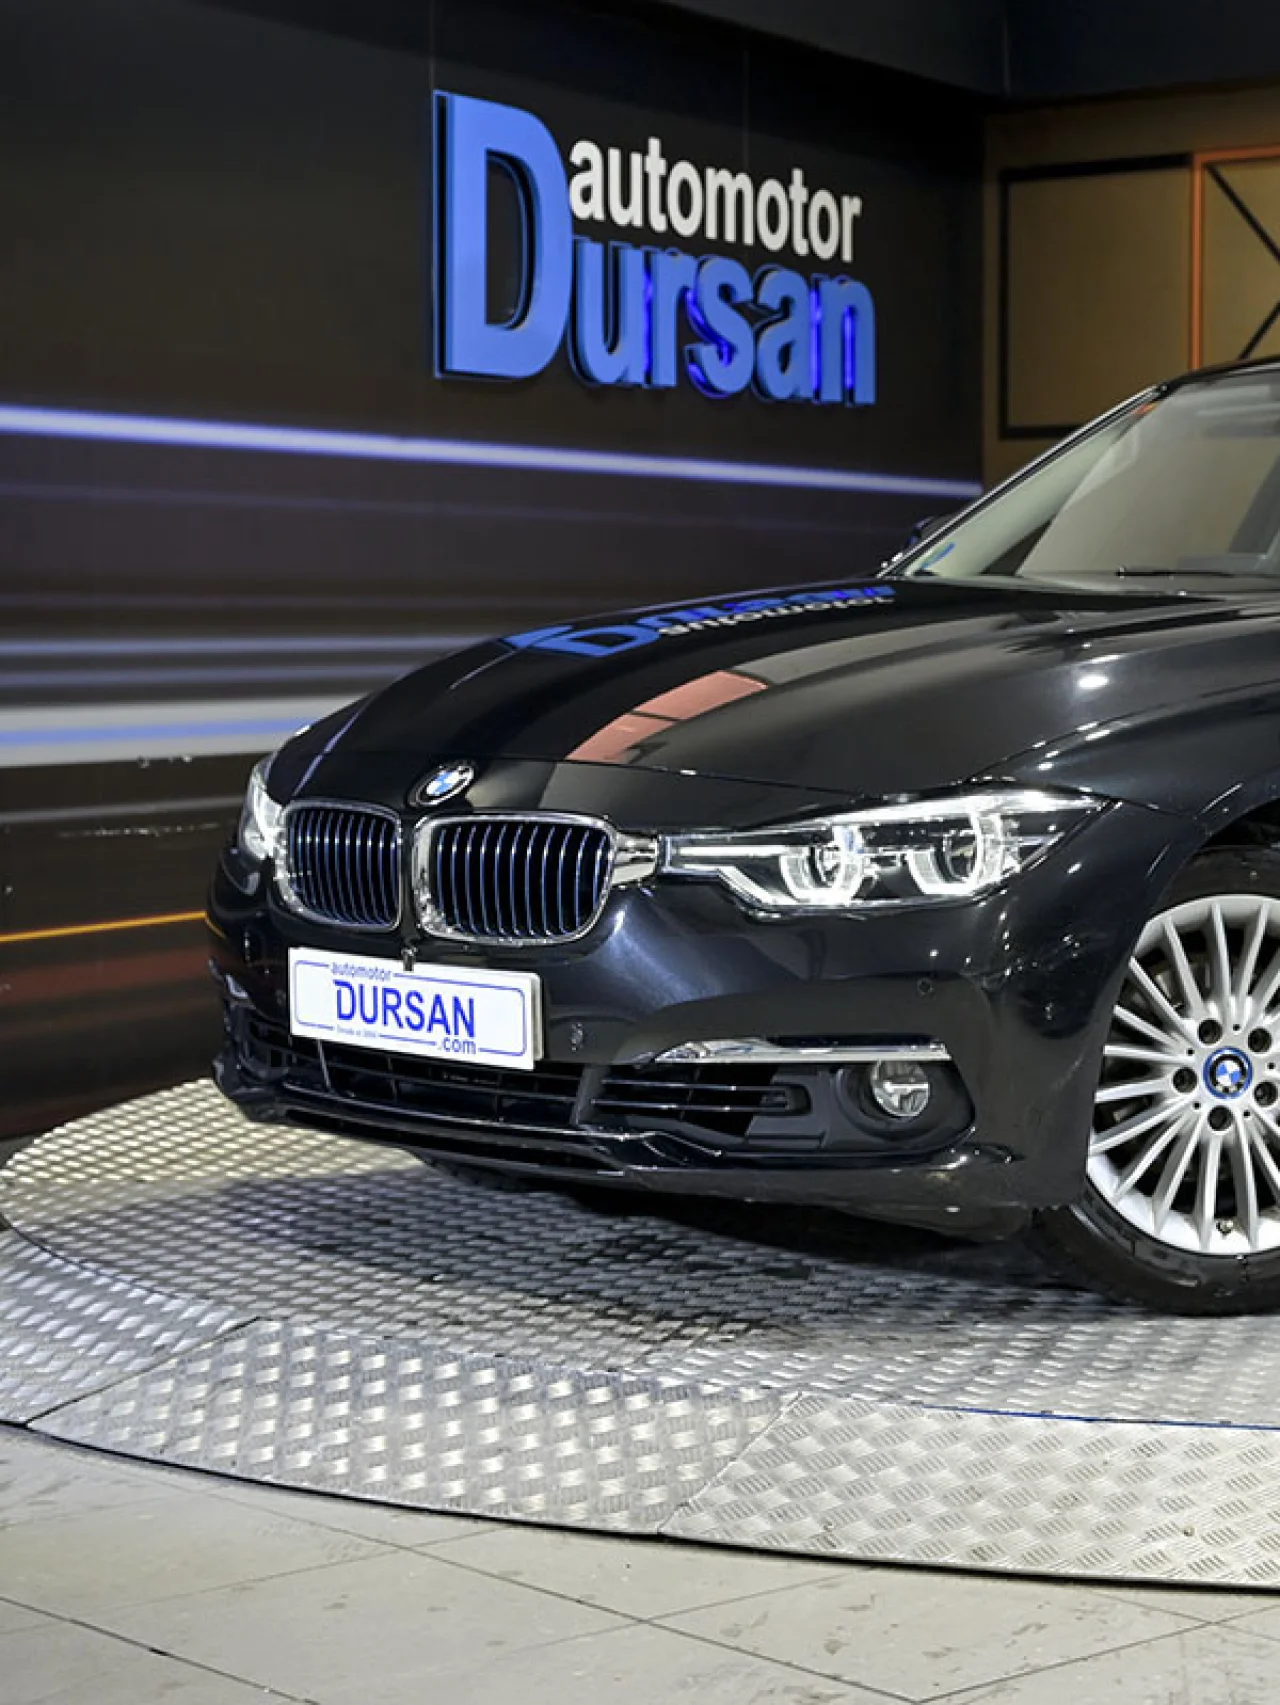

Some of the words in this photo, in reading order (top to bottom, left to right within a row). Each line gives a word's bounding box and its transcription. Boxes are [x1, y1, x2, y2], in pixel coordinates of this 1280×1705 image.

[568, 136, 862, 262] automotor
[433, 89, 876, 406] Dursan
[331, 961, 392, 982] automotor
[333, 979, 475, 1038] DURSAN
[437, 1036, 477, 1055] .com
